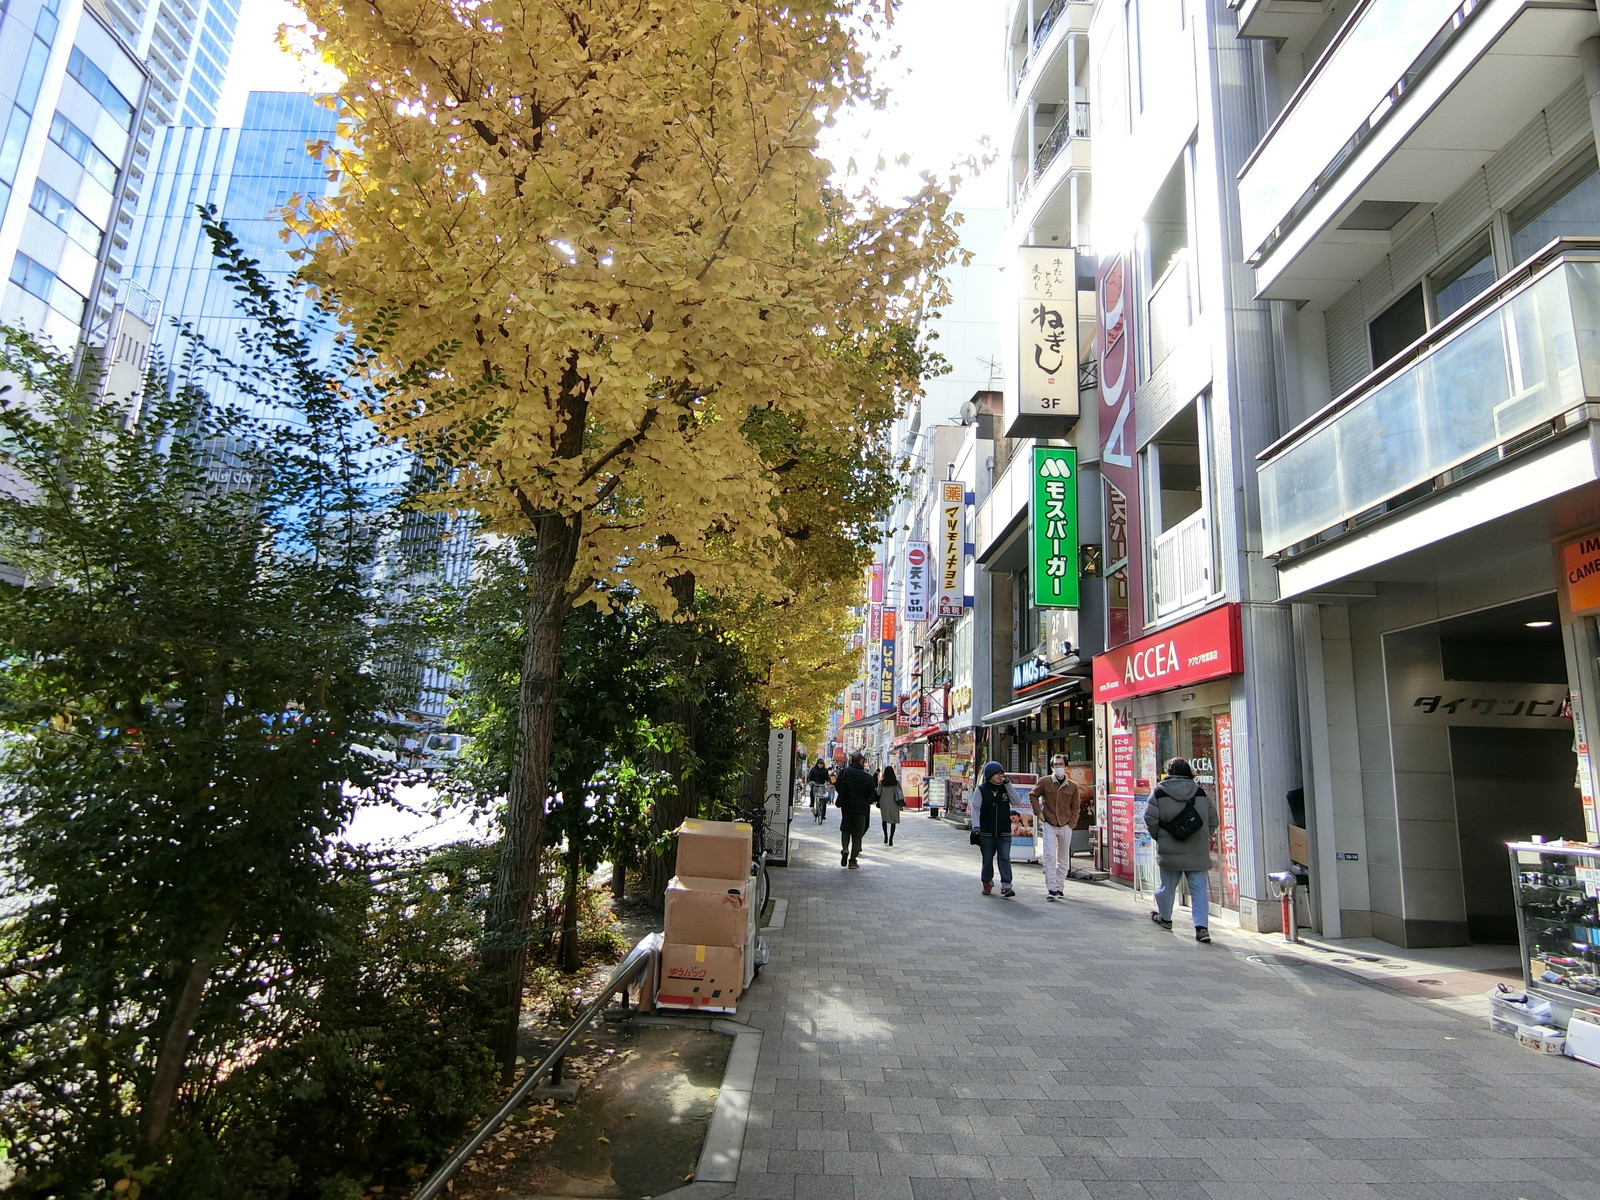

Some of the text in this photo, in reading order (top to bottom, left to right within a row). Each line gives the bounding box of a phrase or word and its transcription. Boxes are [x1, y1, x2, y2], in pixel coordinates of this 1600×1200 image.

[1030, 302, 1067, 376] ねぎし
[1040, 397, 1061, 409] 3F
[945, 486, 961, 501] 薬
[944, 506, 960, 589] マツモトキヨシ
[1045, 481, 1068, 597] モスバーガー
[908, 566, 923, 612] 天下一品
[942, 606, 960, 615] 免税
[1022, 658, 1040, 686] MOS
[1124, 640, 1180, 685] ACCEA
[1113, 705, 1128, 730] 24
[775, 741, 784, 791] INFORMATION
[669, 967, 707, 978] ゆうパック
